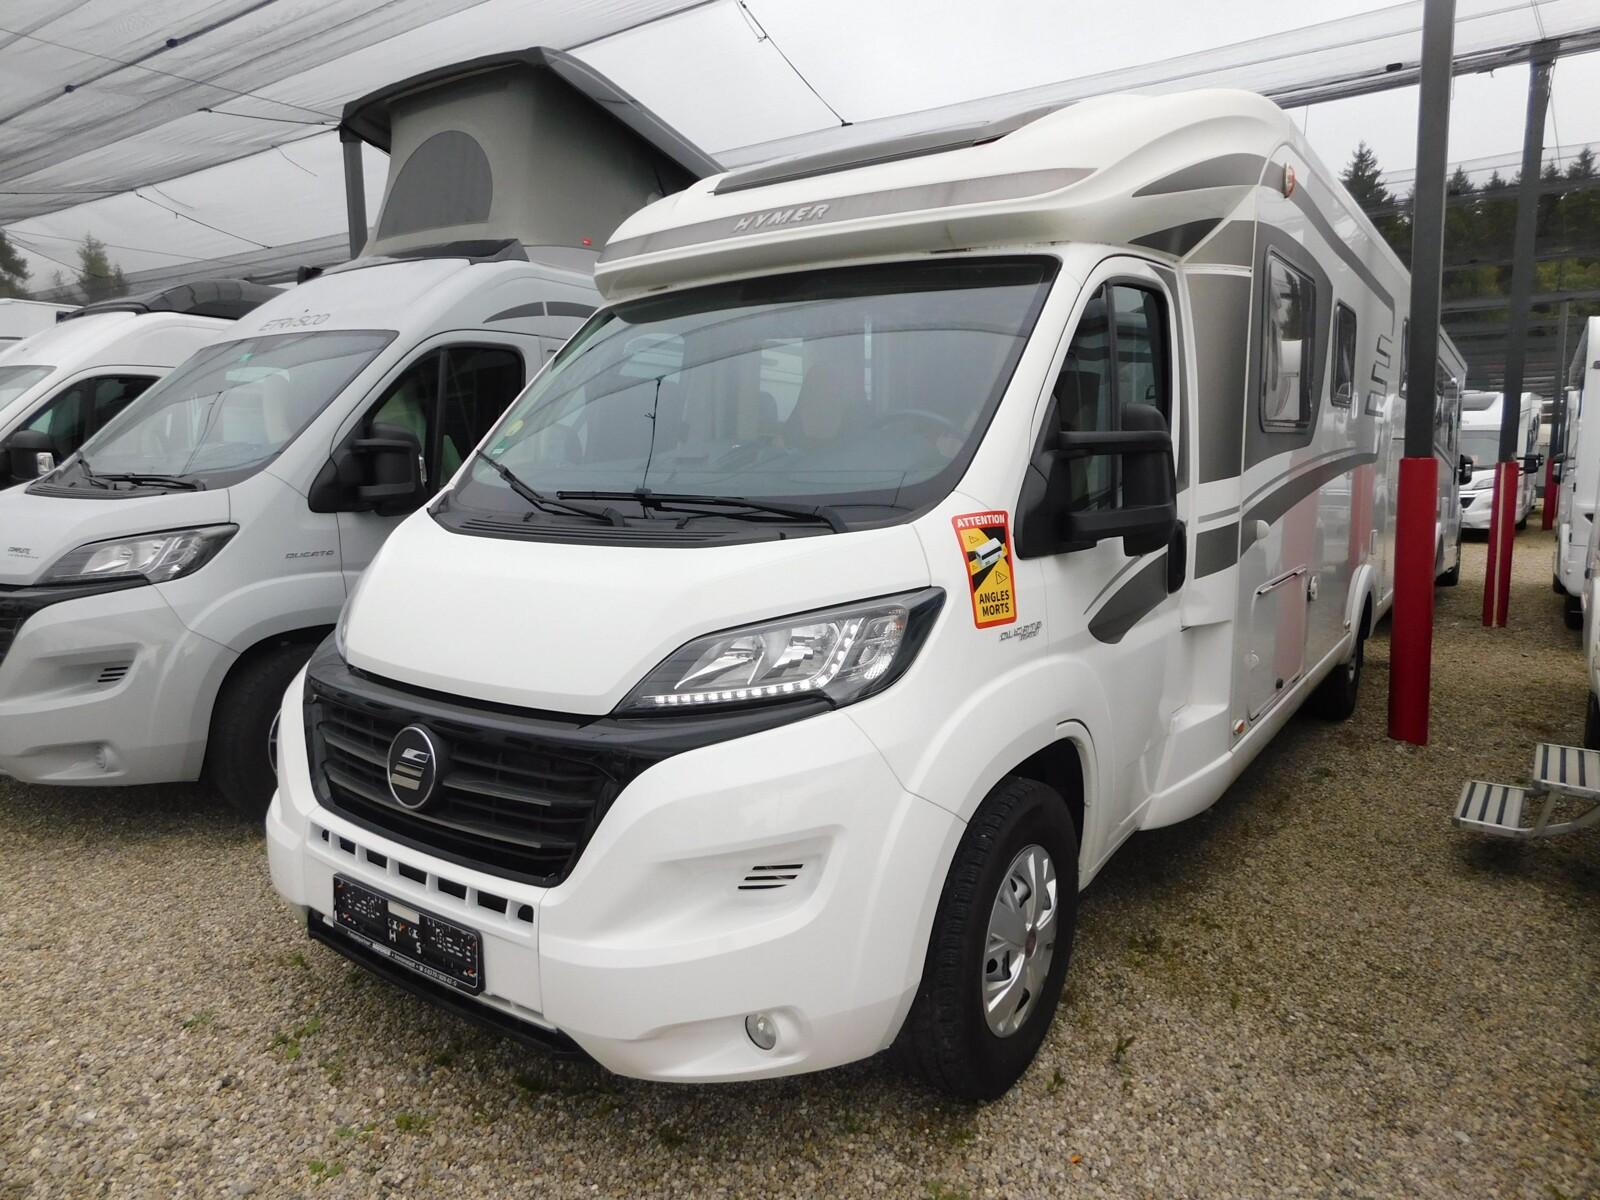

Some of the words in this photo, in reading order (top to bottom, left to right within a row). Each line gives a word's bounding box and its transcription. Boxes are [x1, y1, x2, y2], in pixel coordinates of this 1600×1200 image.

[733, 204, 829, 232] HYMER
[957, 514, 1005, 528] ATTENTION
[285, 550, 335, 559] DUCATO
[979, 589, 1010, 605] ANGLES
[982, 602, 1010, 617] MORTS
